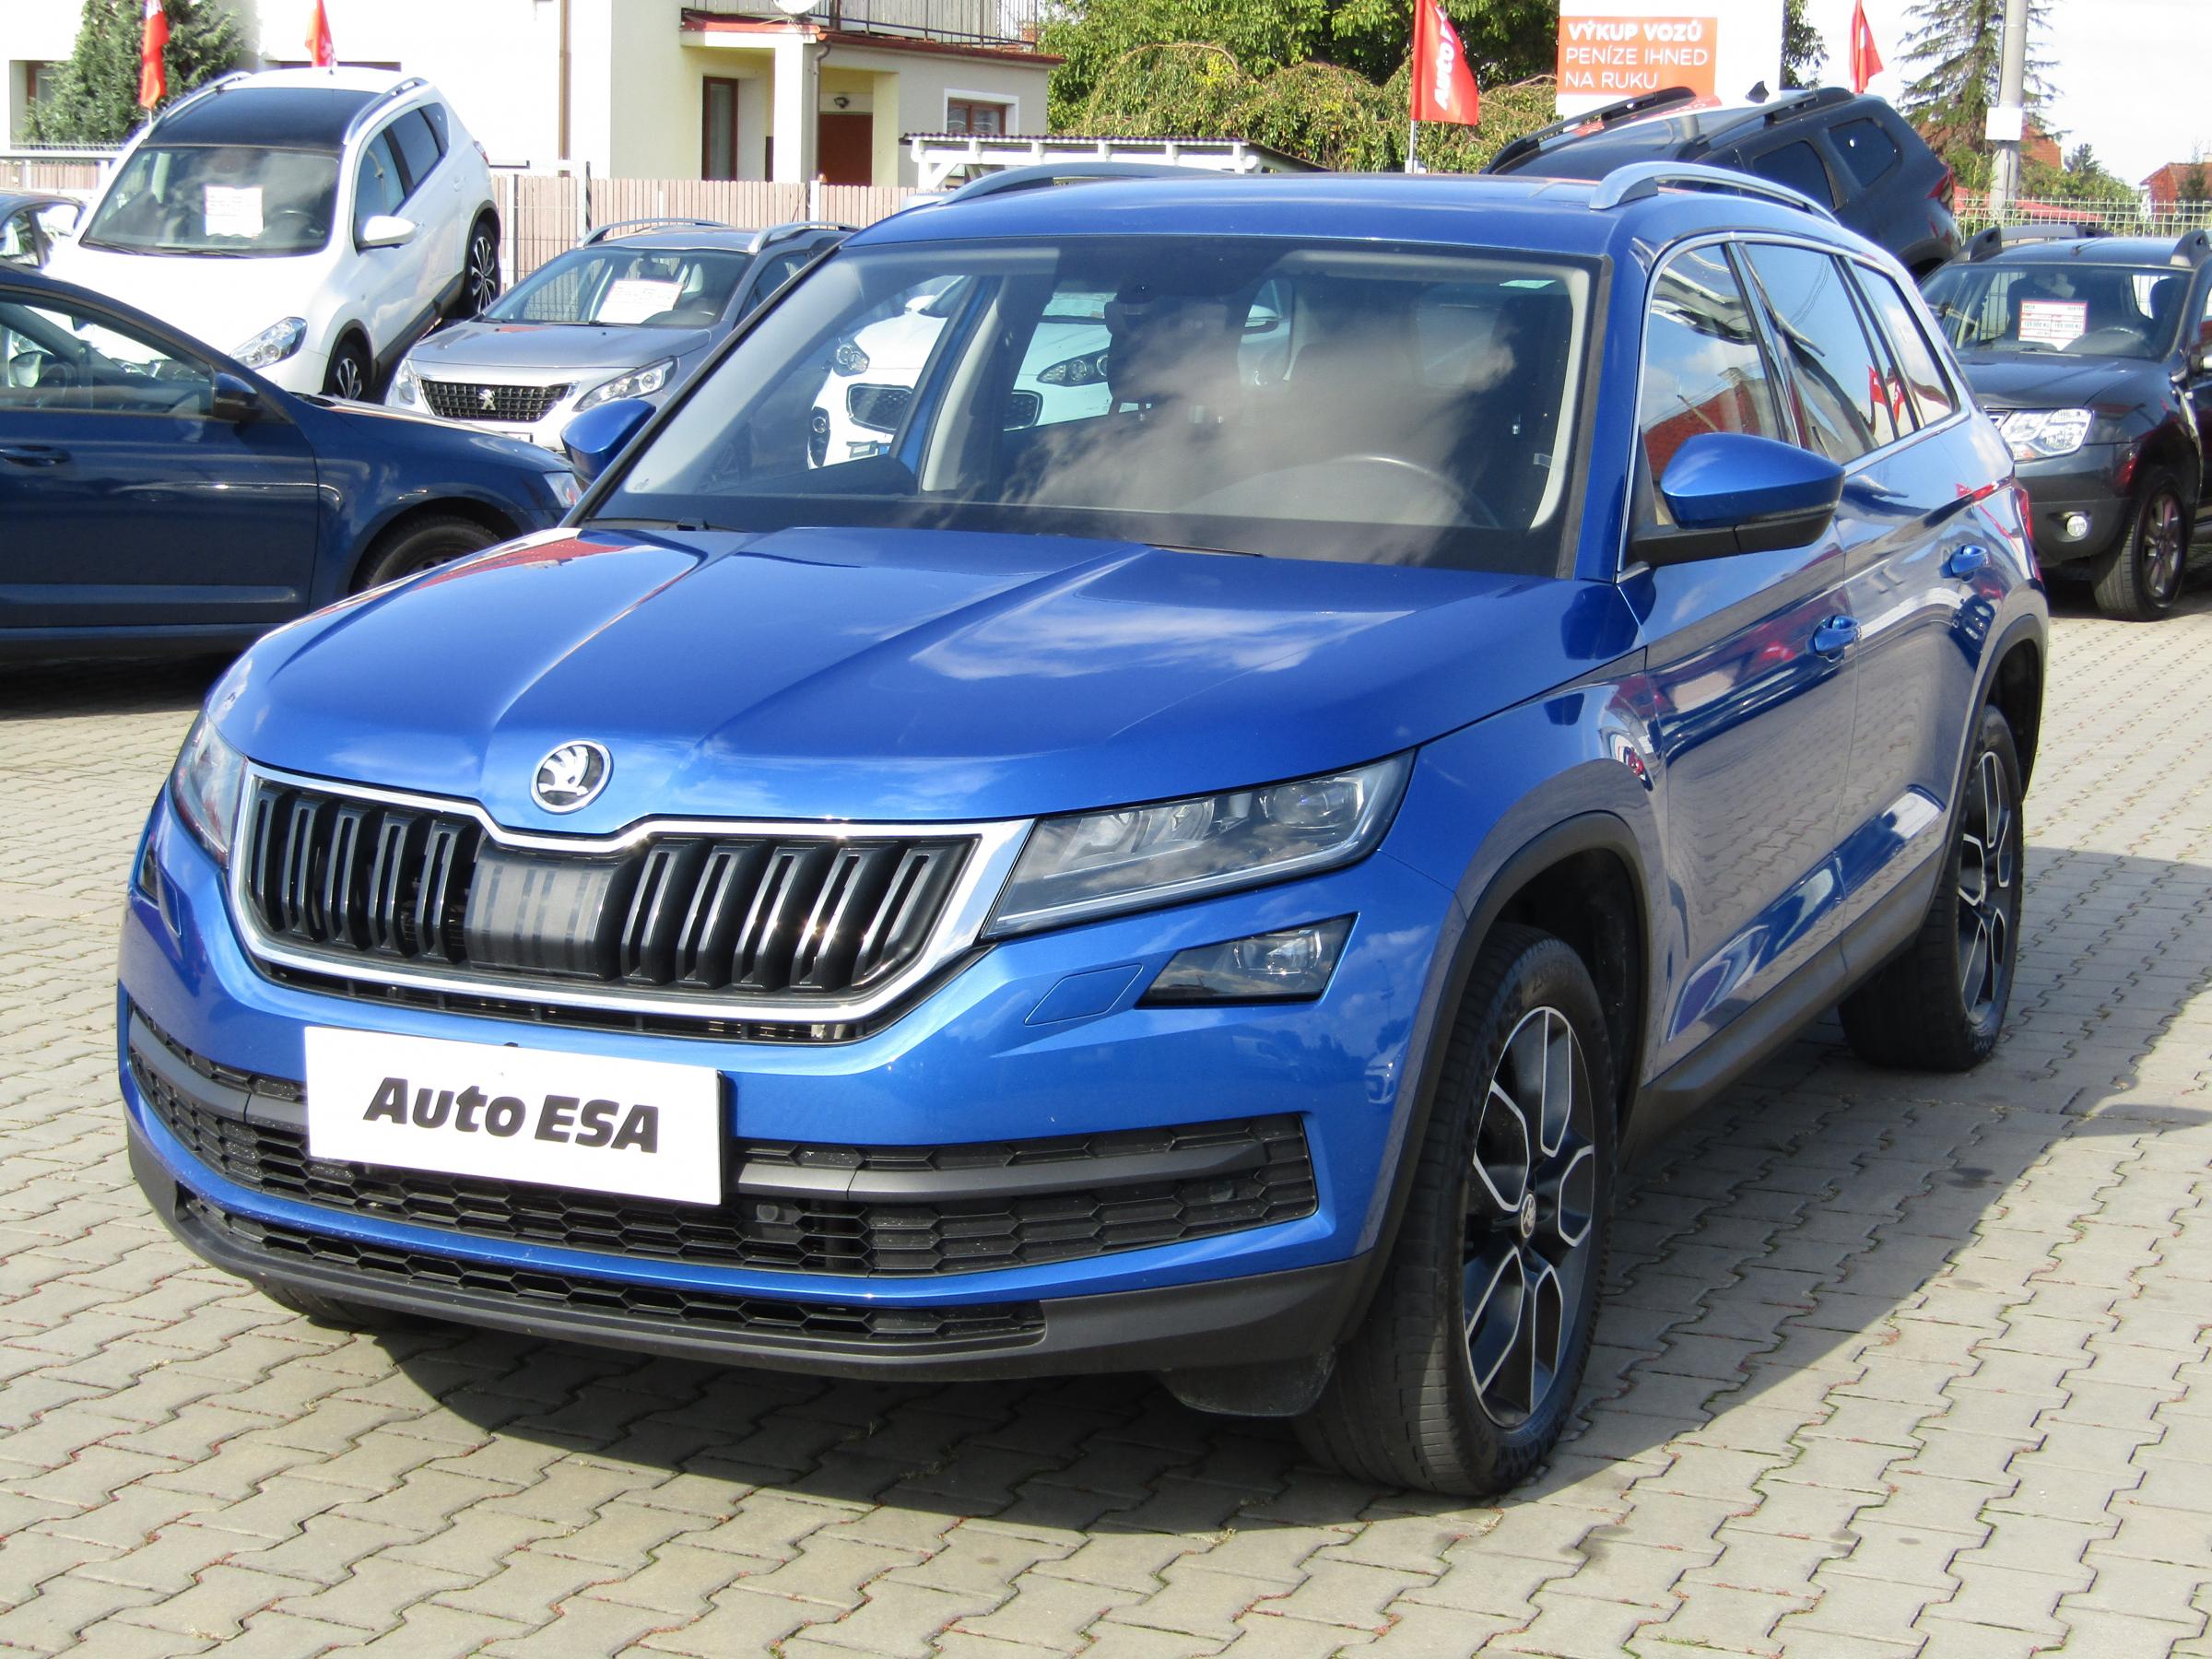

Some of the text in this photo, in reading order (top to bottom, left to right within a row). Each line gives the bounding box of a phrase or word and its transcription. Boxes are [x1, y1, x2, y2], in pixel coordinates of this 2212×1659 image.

[1568, 20, 1702, 42] VÝKUP VOZŮ
[1565, 45, 1709, 66] PENÍZE IHNED
[1565, 72, 1658, 89] NA RUKU
[363, 1077, 659, 1154] Auto ESA
